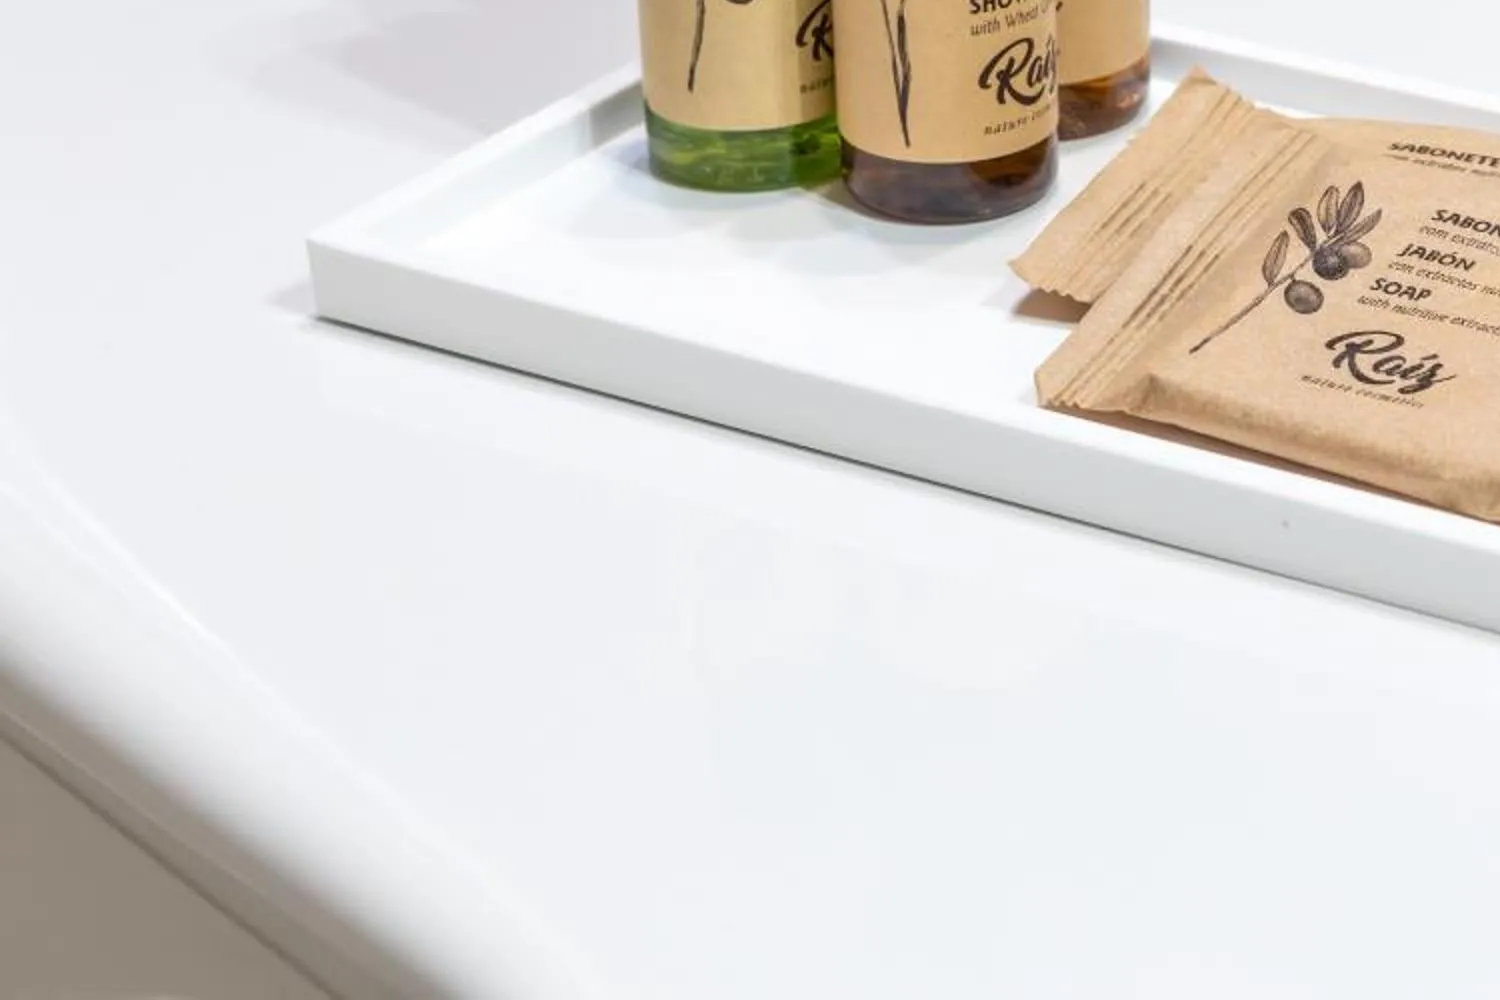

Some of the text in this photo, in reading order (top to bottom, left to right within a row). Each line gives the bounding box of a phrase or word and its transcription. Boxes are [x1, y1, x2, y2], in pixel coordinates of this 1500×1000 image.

[970, 17, 1001, 37] with
[1395, 243, 1477, 272] JABÓN
[1369, 276, 1433, 302] SOAP
[1357, 294, 1391, 310] with
